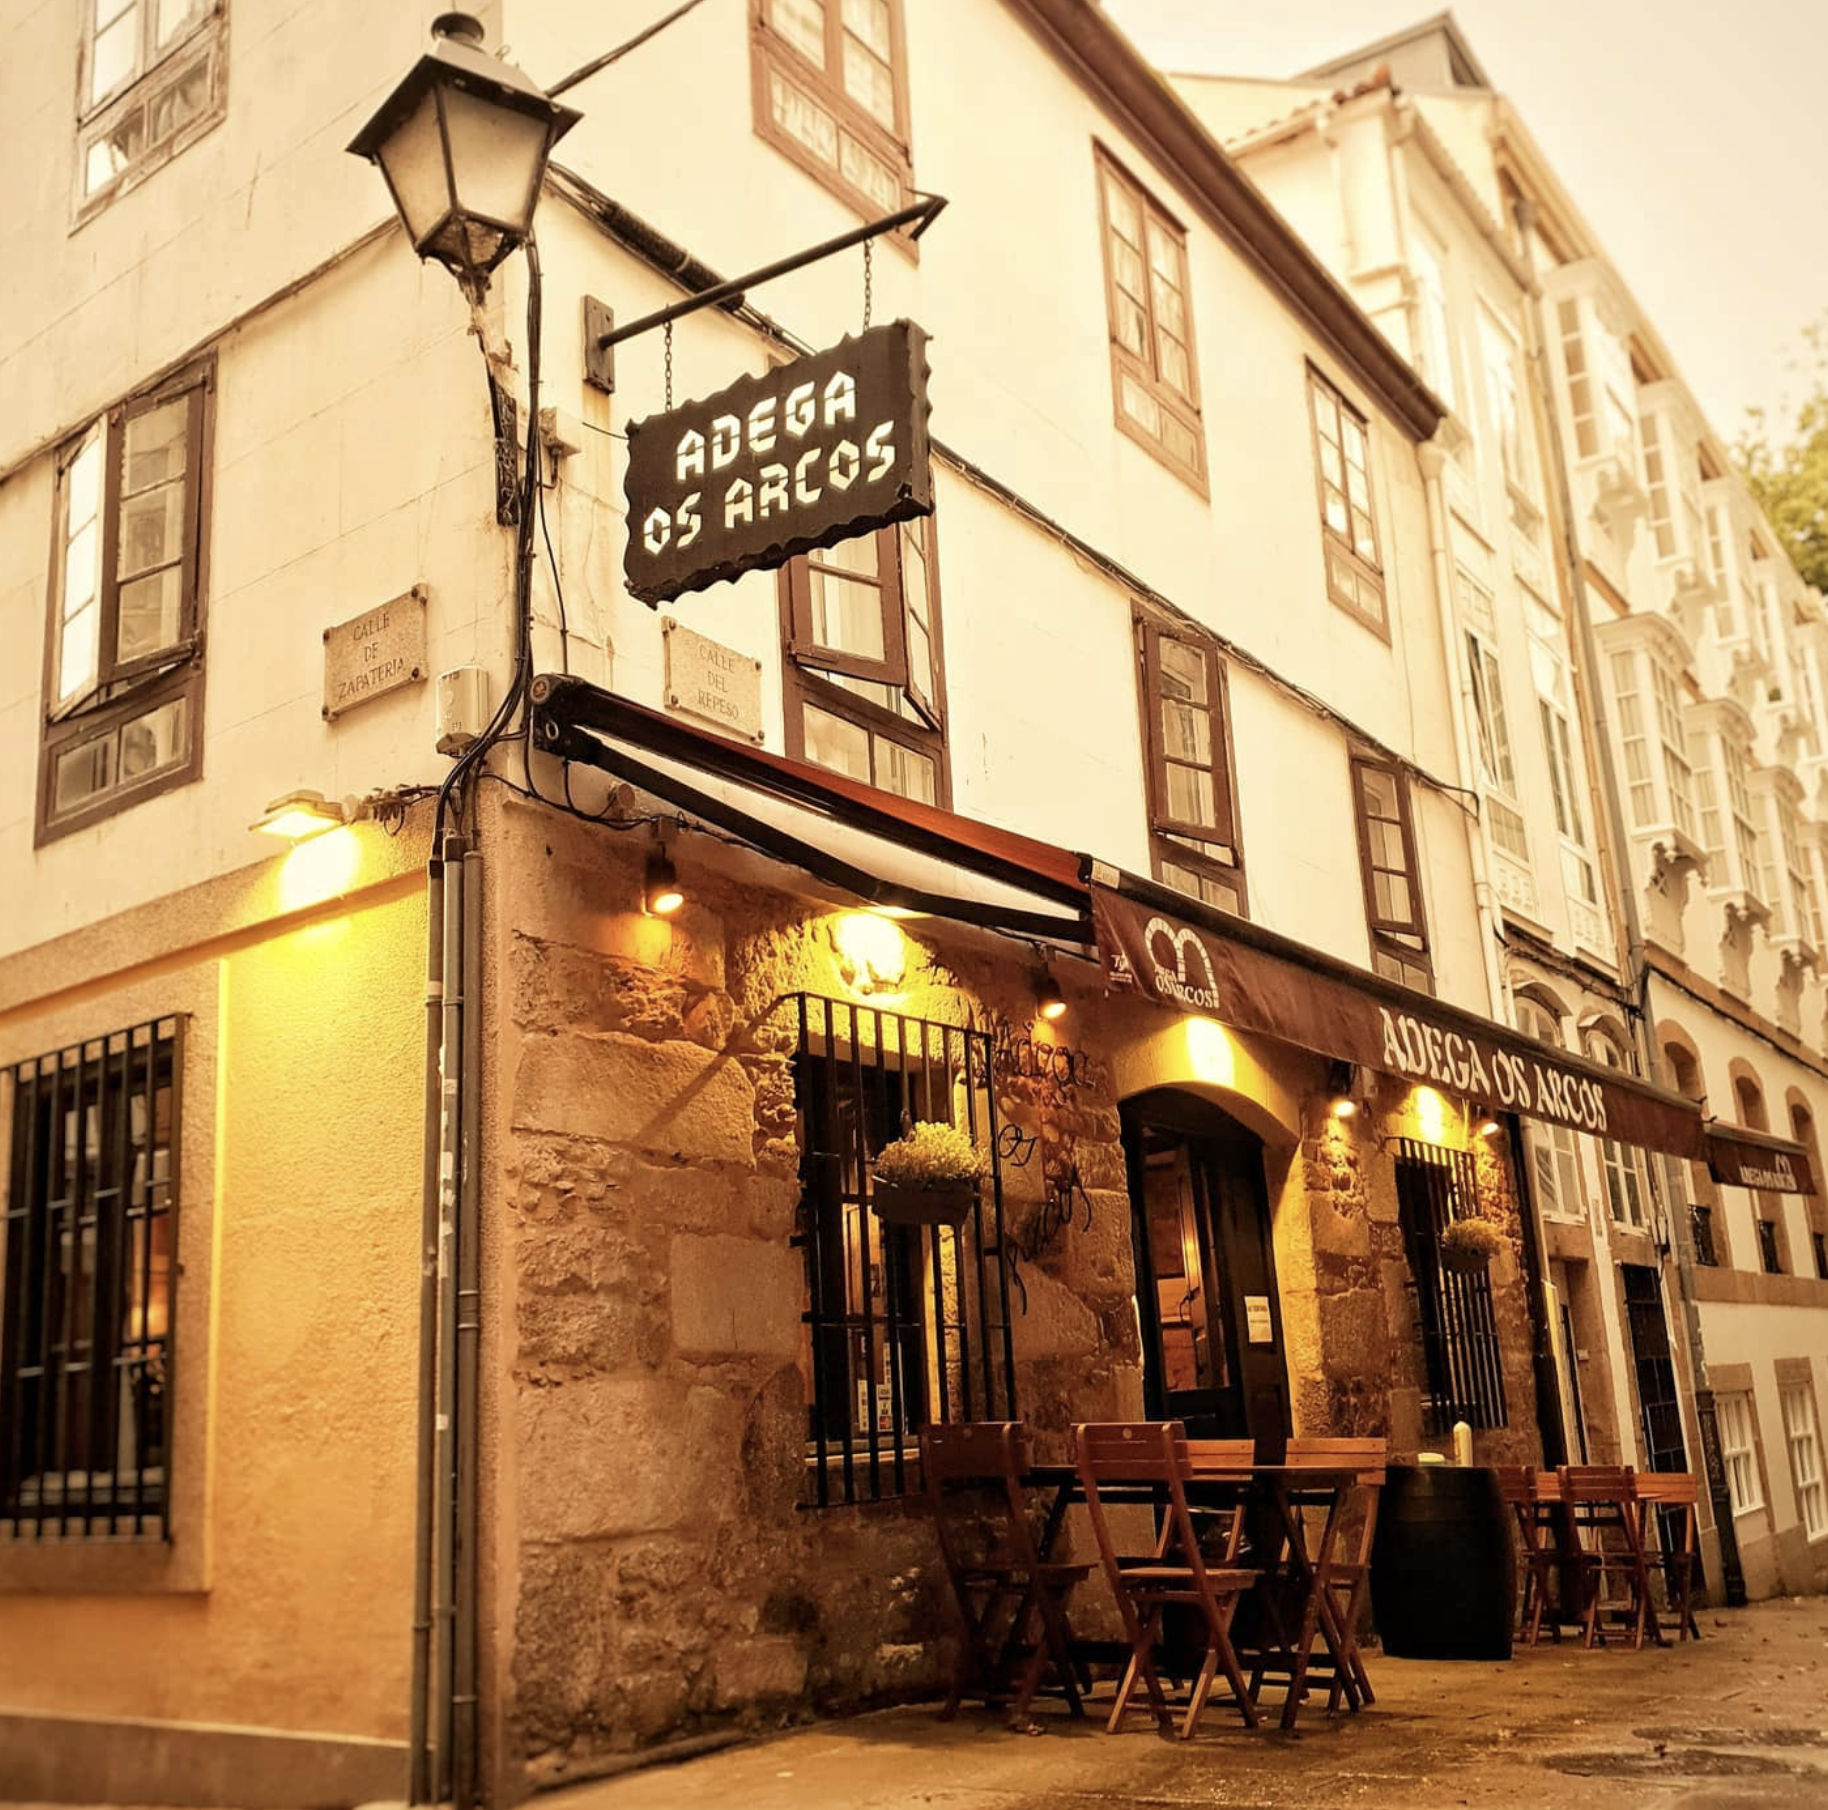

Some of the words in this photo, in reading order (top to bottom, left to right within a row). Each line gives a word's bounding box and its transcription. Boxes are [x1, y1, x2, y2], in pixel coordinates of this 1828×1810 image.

[676, 370, 856, 482] ADEGA
[643, 491, 702, 556] OS
[724, 420, 896, 529] ARCOS
[353, 611, 390, 641] CALLE
[364, 641, 379, 663] DE
[699, 644, 735, 674] CALLE
[707, 670, 728, 693] DEL
[698, 689, 739, 720] REPESO
[1379, 1006, 1491, 1096] ADEGA
[1492, 1049, 1531, 1109] OS
[1534, 1063, 1608, 1132] ARCOS
